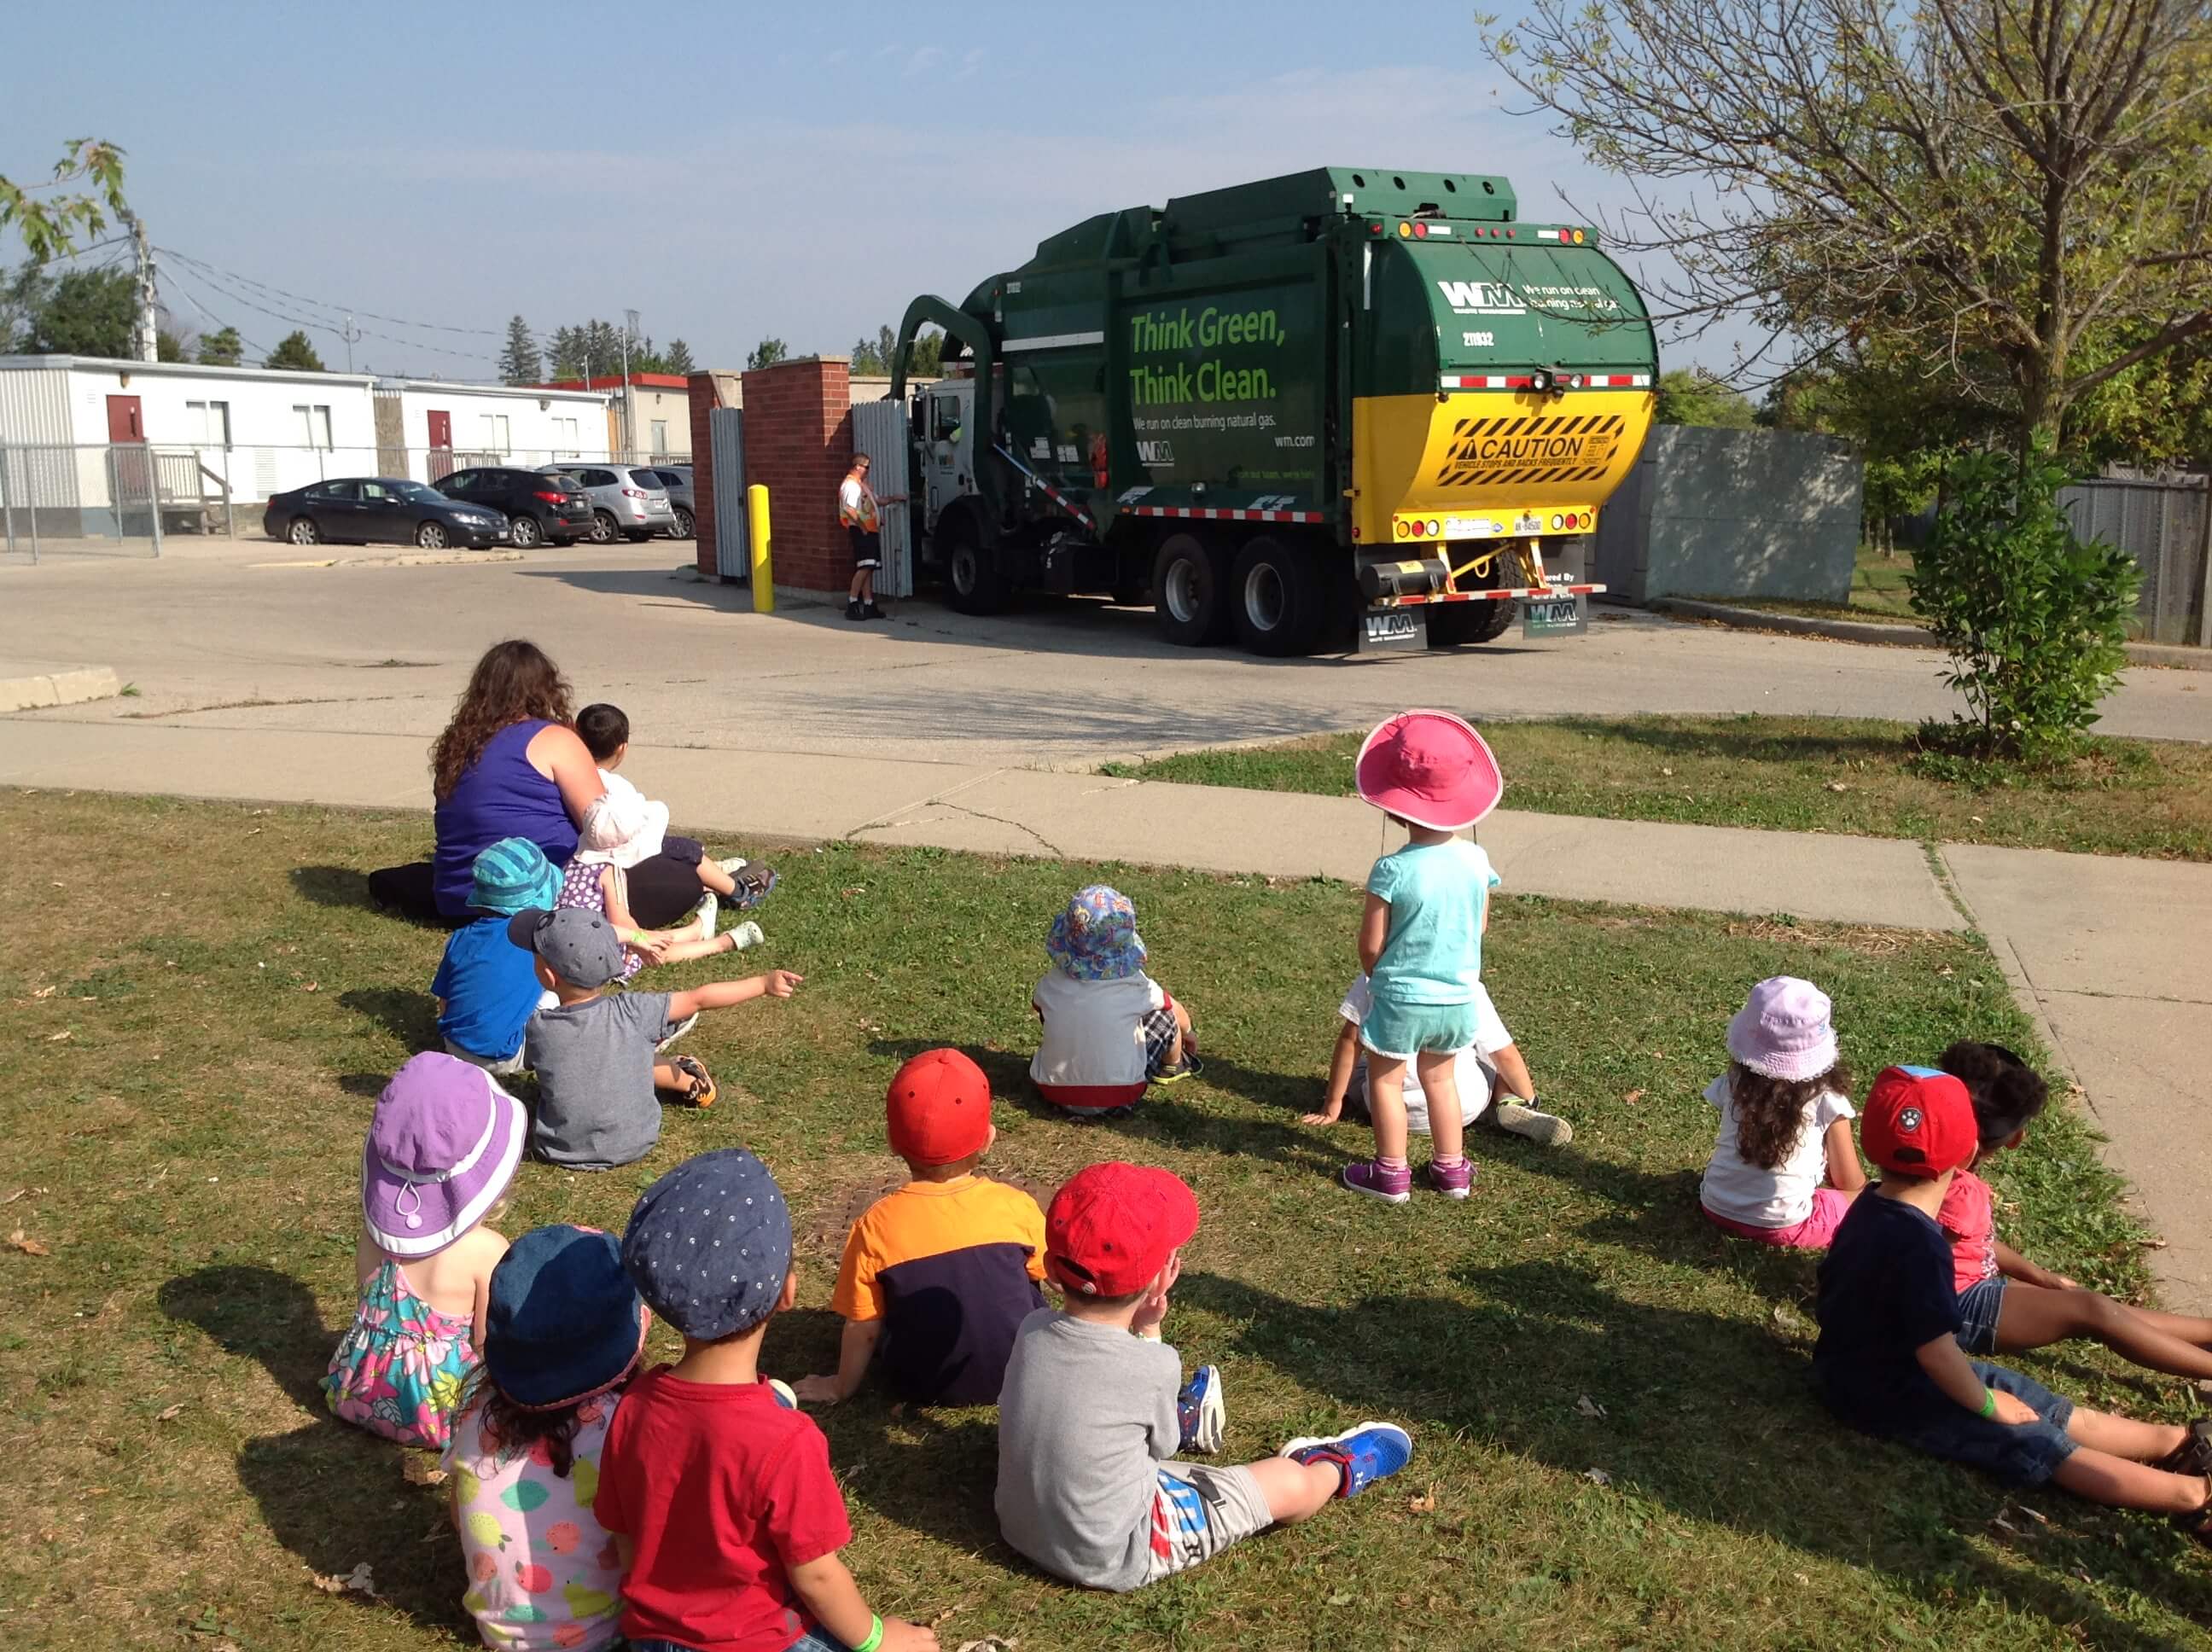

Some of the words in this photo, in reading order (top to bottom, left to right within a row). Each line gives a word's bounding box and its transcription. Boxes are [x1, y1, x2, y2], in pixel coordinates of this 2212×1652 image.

[1522, 284, 1540, 294] We
[1541, 286, 1559, 294] run
[1132, 308, 1195, 352] Think
[1198, 307, 1284, 346] Green,
[1130, 362, 1193, 404] Think
[1196, 359, 1276, 402] Clean.
[1133, 417, 1145, 430] We
[1161, 418, 1171, 429] on
[1172, 416, 1192, 428] clean
[1193, 415, 1225, 431] burning
[1227, 412, 1256, 427] natural
[1258, 415, 1277, 430] gas.
[1275, 435, 1314, 447] wm.com
[1481, 438, 1583, 459] CAUTION
